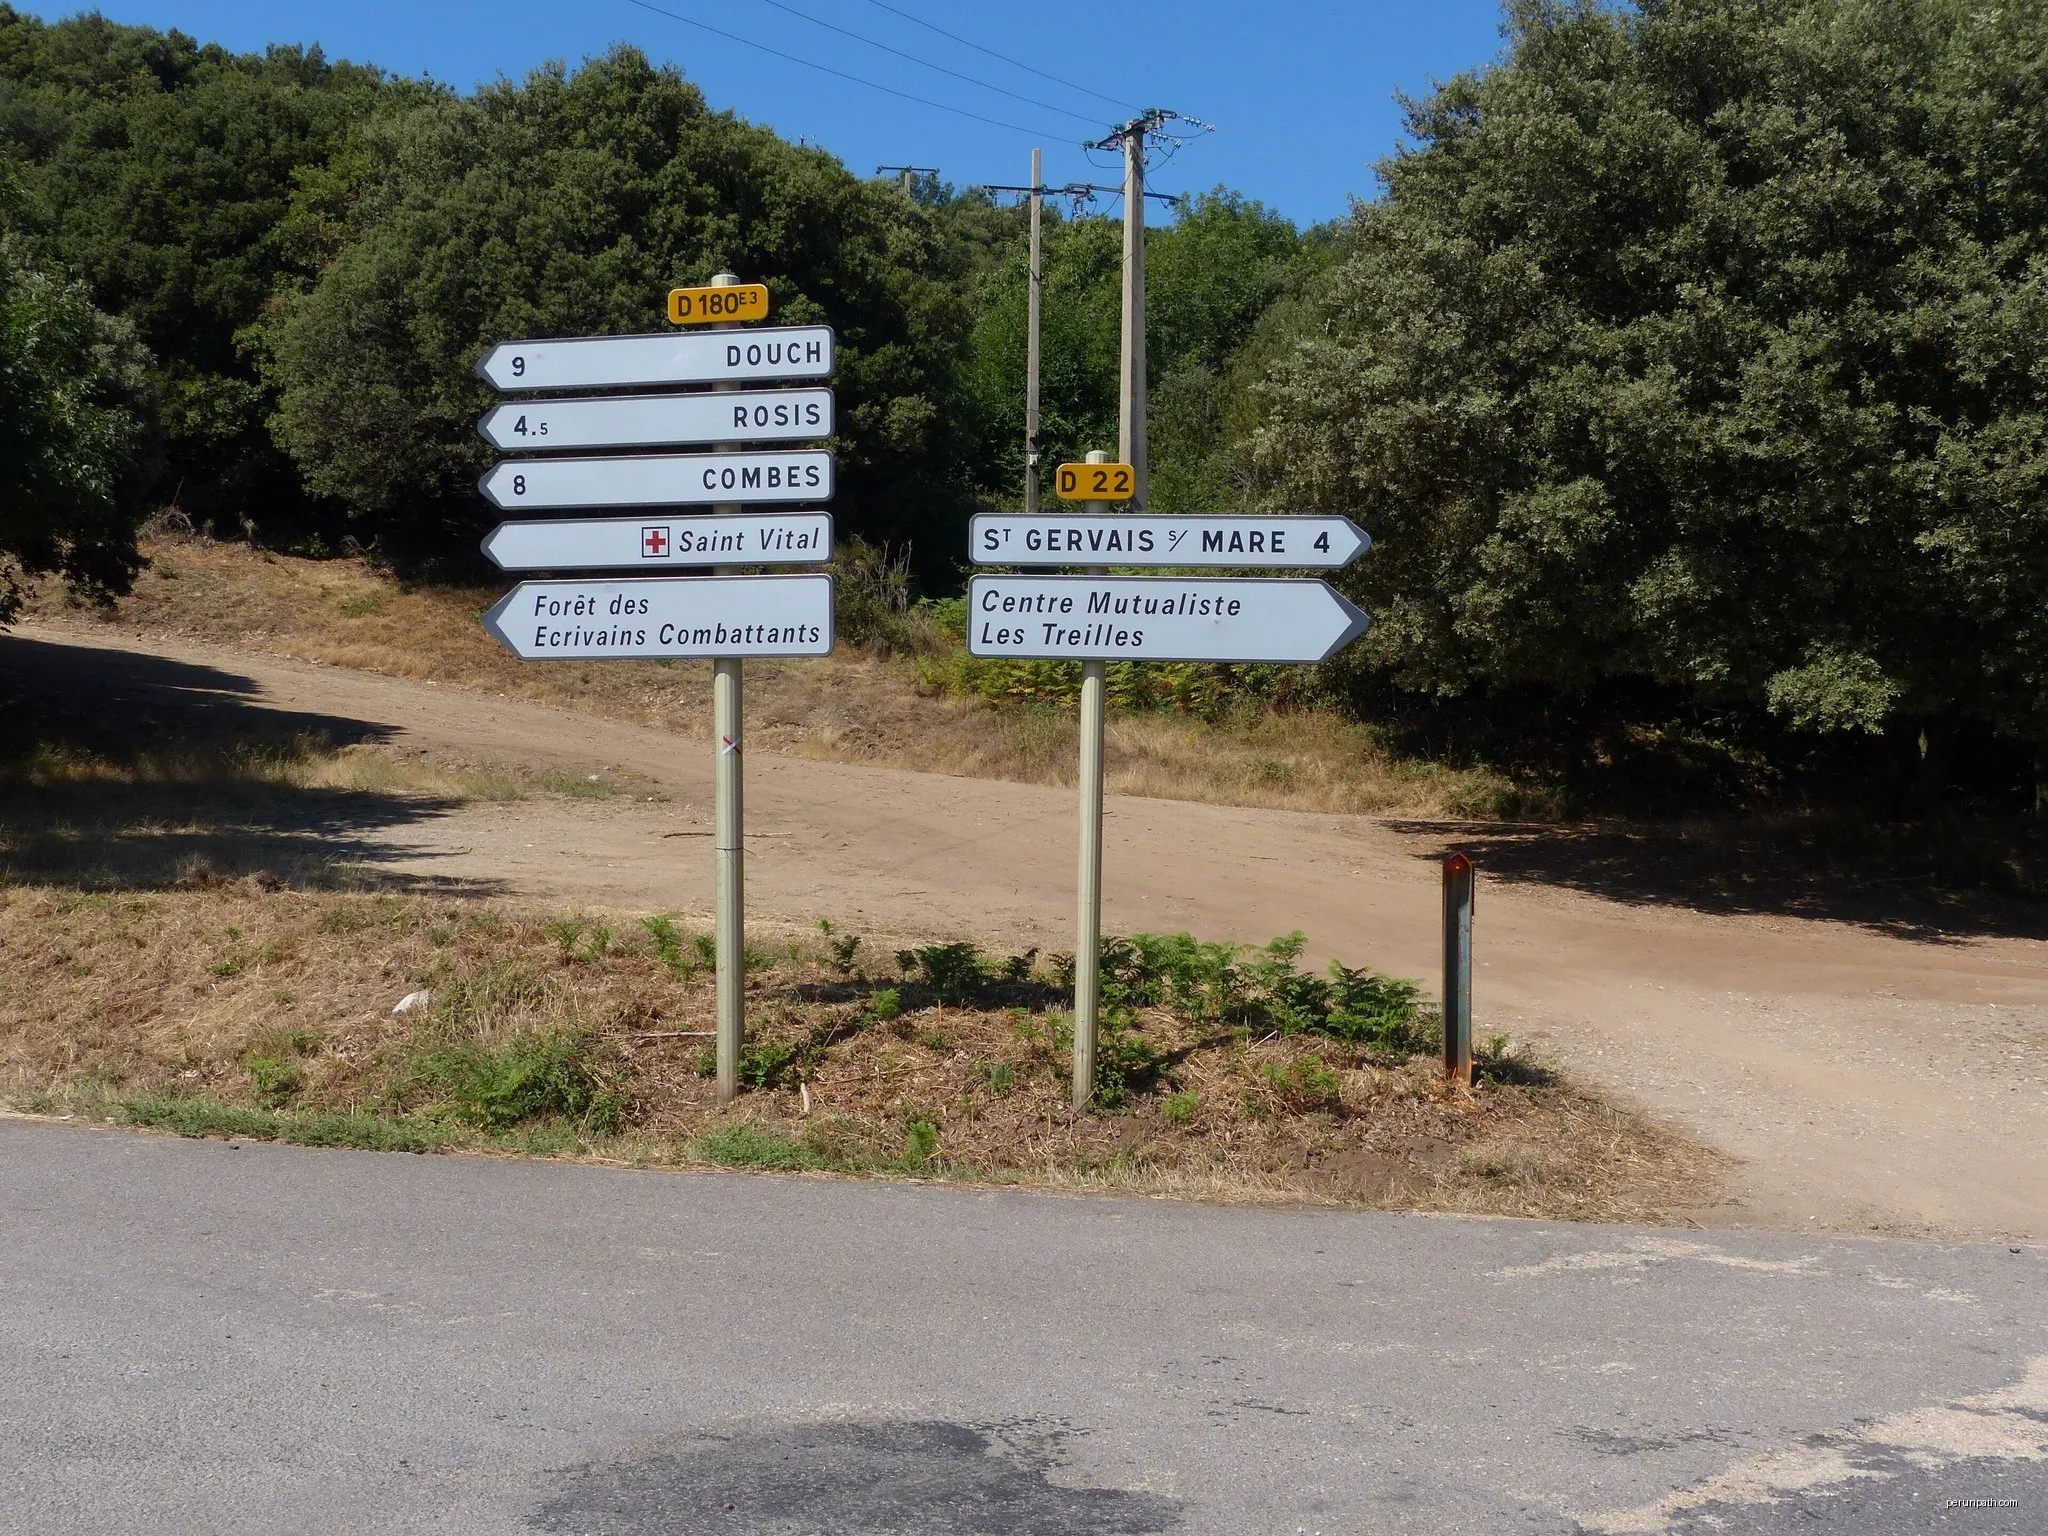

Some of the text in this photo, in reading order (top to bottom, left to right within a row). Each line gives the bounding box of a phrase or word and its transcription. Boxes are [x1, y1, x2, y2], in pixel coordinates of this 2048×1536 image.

[677, 295, 692, 317] D
[511, 341, 822, 377] 9 DOUCH
[733, 403, 821, 428] ROSIS
[513, 465, 821, 496] 8 COMBES
[1060, 470, 1130, 493] D 22
[678, 527, 820, 552] Saint Vital
[1025, 529, 1155, 552] GERVAIS
[1202, 530, 1285, 553] MARE
[1313, 531, 1330, 553] 4
[534, 593, 649, 616] Forêt des
[981, 589, 1241, 617] Centre Mutualiste
[534, 622, 820, 647] Ecrivains Combattants
[981, 622, 1144, 647] Les Treilles
